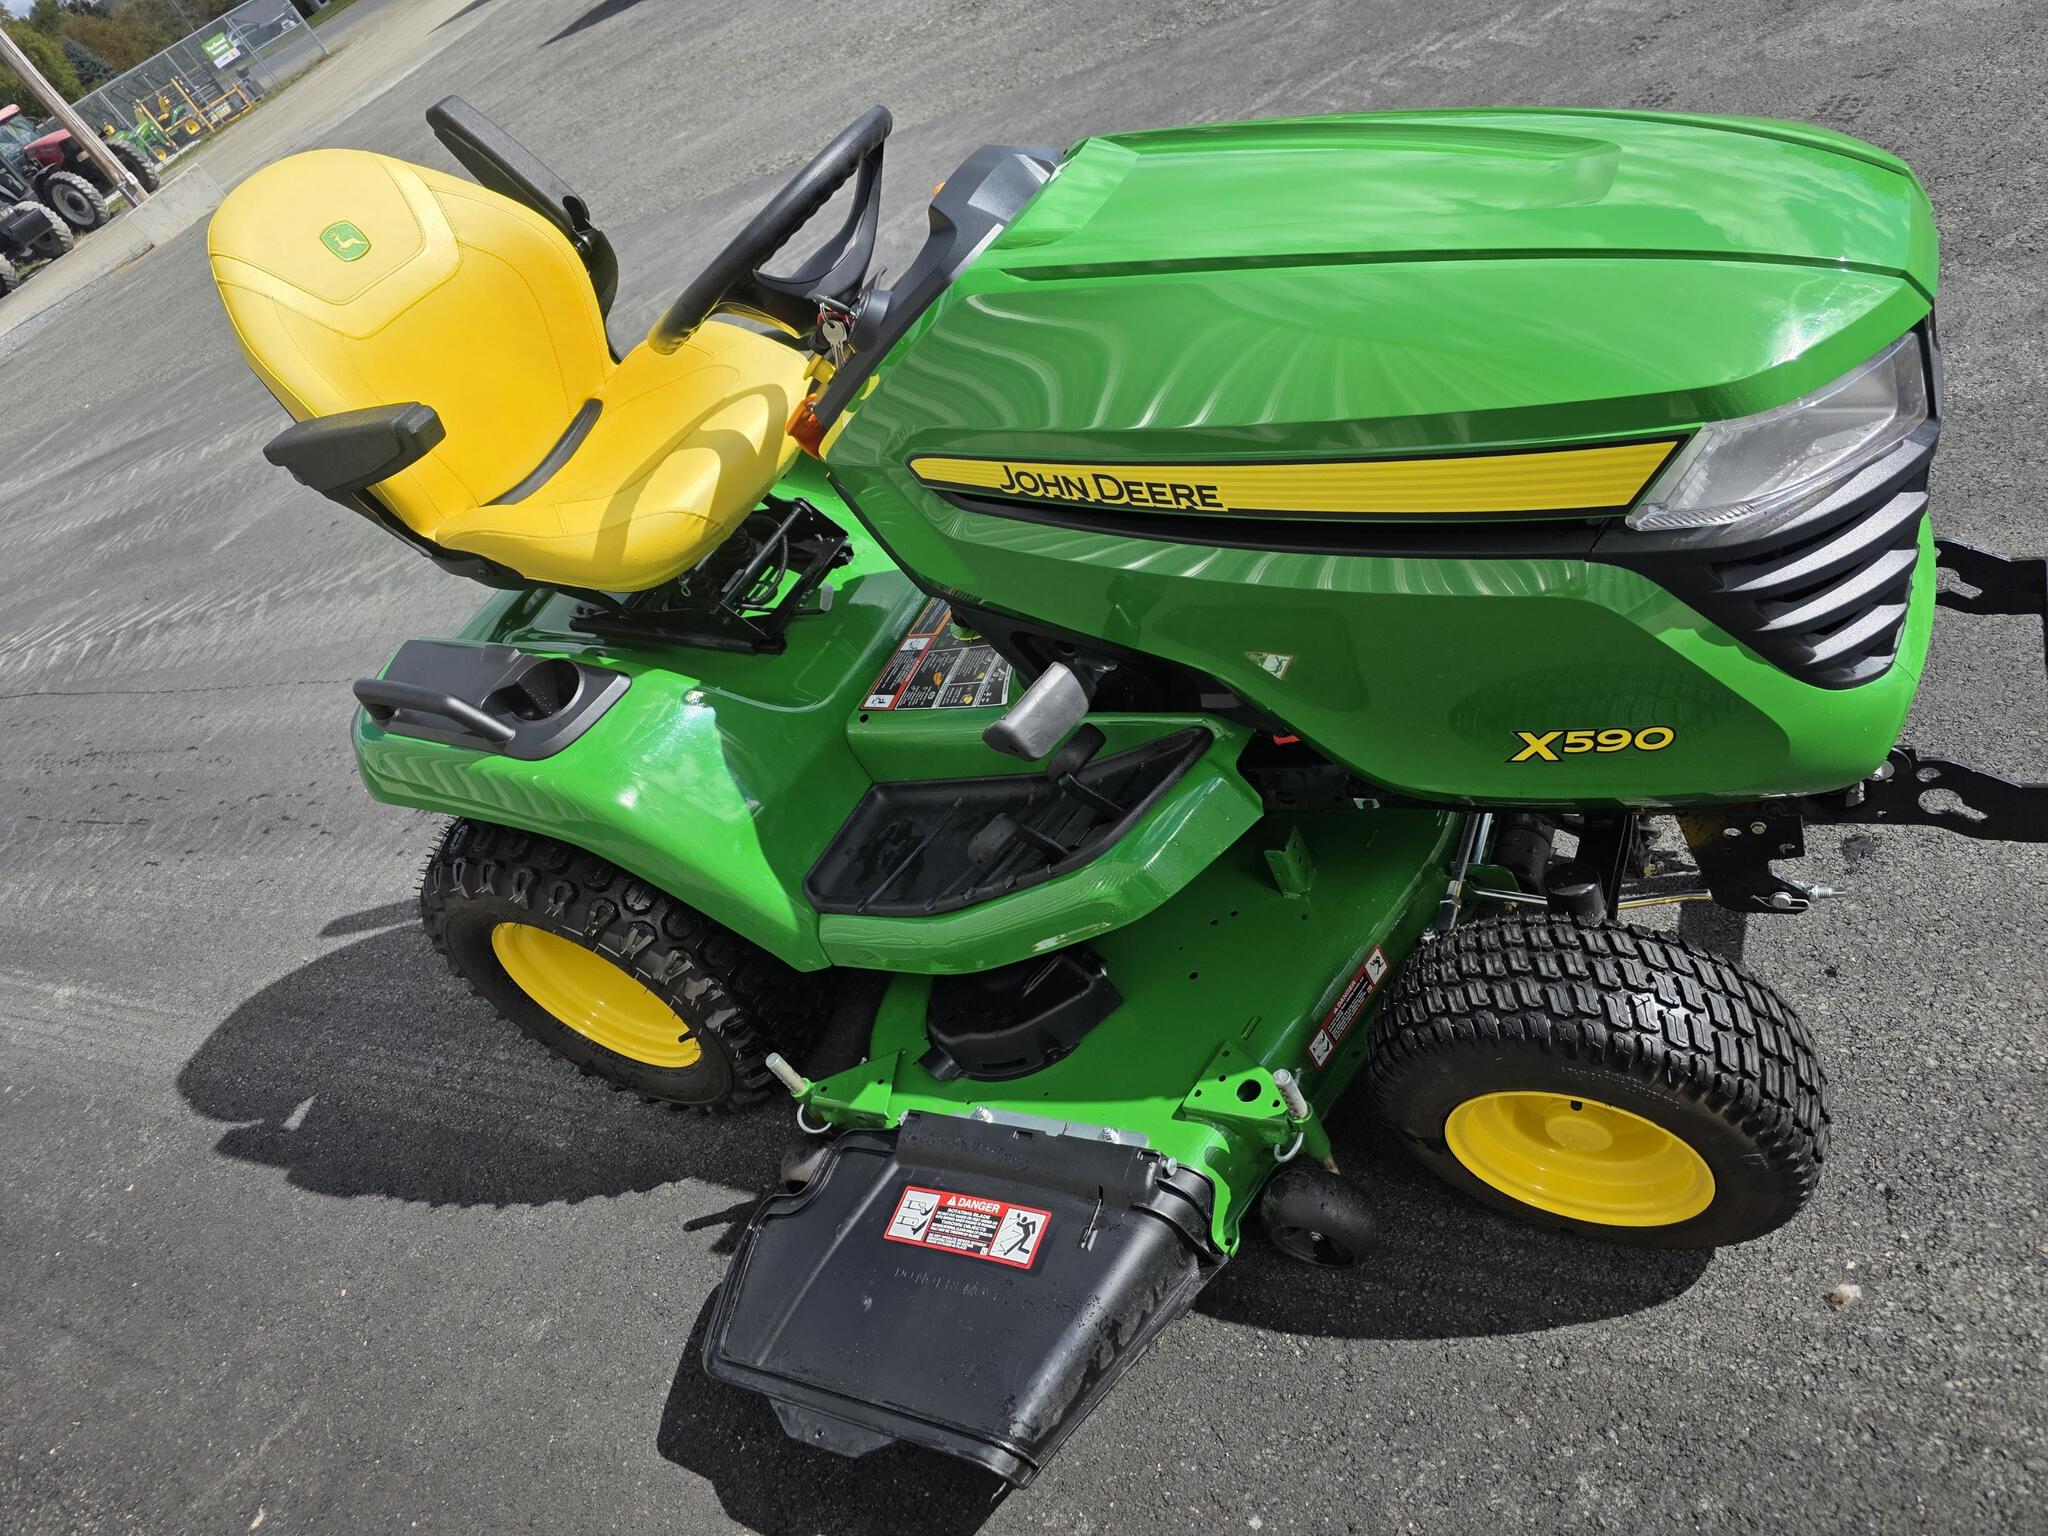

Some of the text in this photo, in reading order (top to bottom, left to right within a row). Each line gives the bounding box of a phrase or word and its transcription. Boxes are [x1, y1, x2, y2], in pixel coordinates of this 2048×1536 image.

[1000, 464, 1225, 510] JOHN DEERE
[1506, 726, 1676, 762] X590
[1336, 980, 1357, 1008] DANGER
[957, 1197, 1001, 1213] DANGER
[973, 1212, 991, 1220] BLADE
[963, 1223, 987, 1232] OBJECTS
